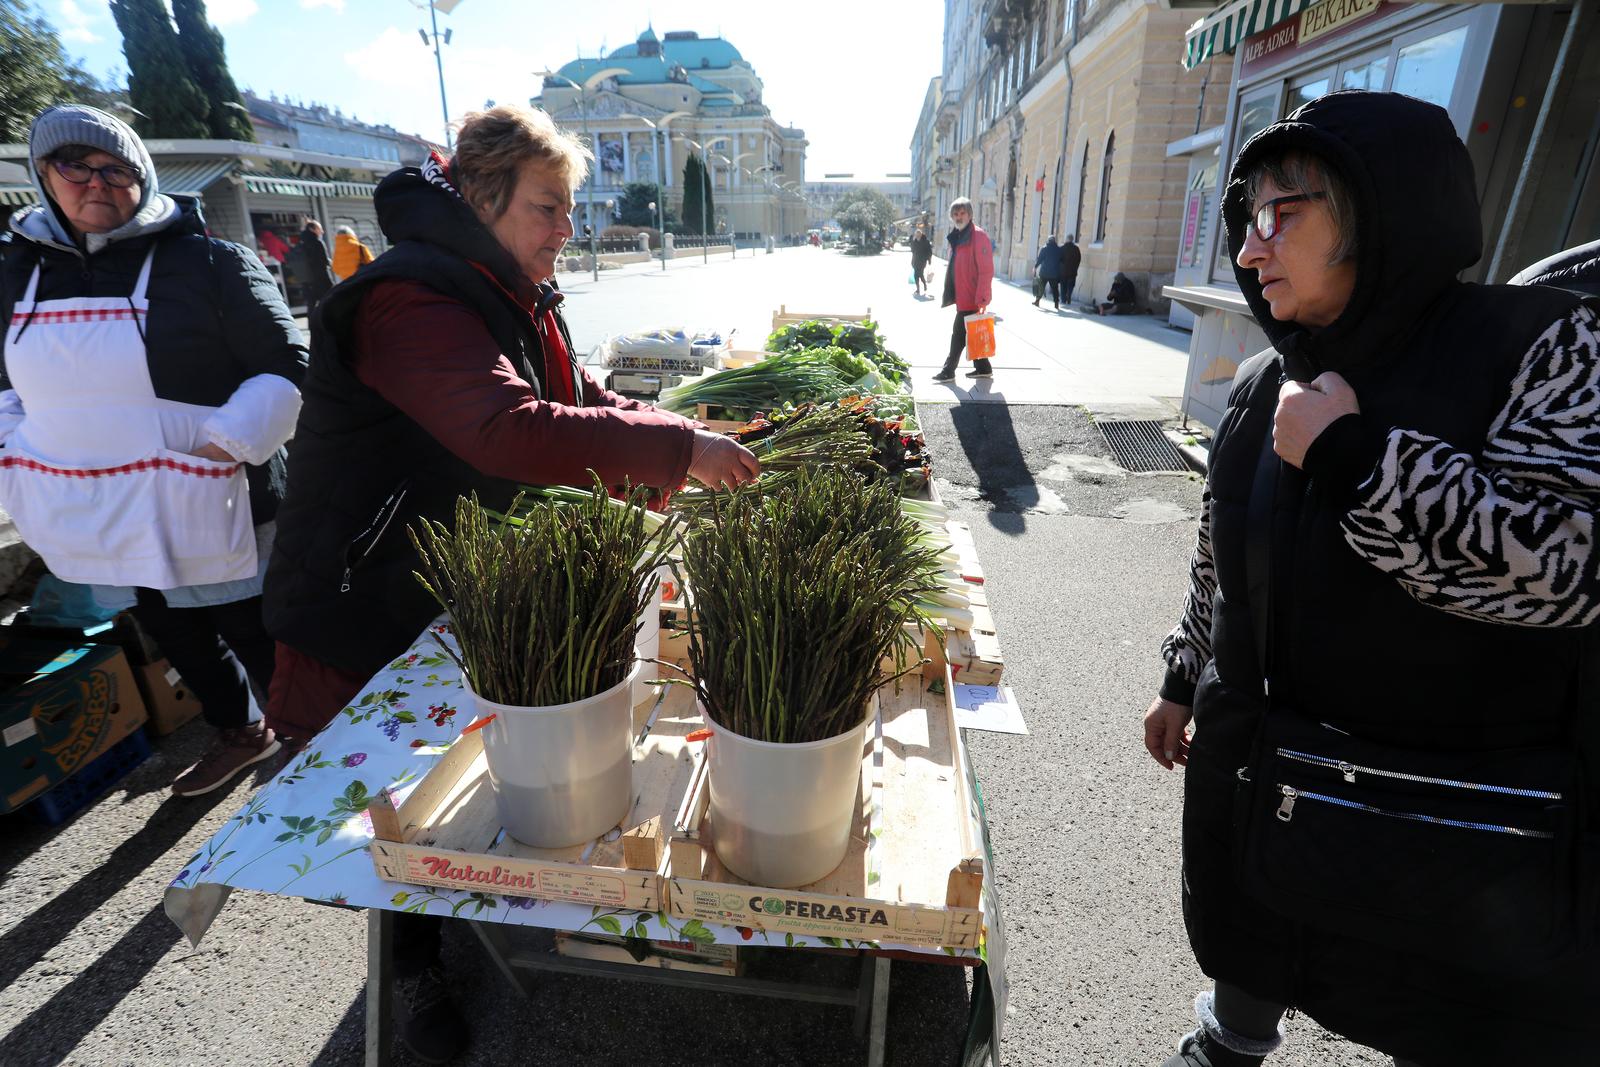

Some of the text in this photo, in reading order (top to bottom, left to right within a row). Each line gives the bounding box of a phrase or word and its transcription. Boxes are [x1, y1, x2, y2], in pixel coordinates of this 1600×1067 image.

[1303, 0, 1373, 37] PEKAR
[1243, 25, 1295, 64] ALPE ADRIA
[421, 856, 536, 889] Natalini
[749, 896, 889, 926] COFERASTA
